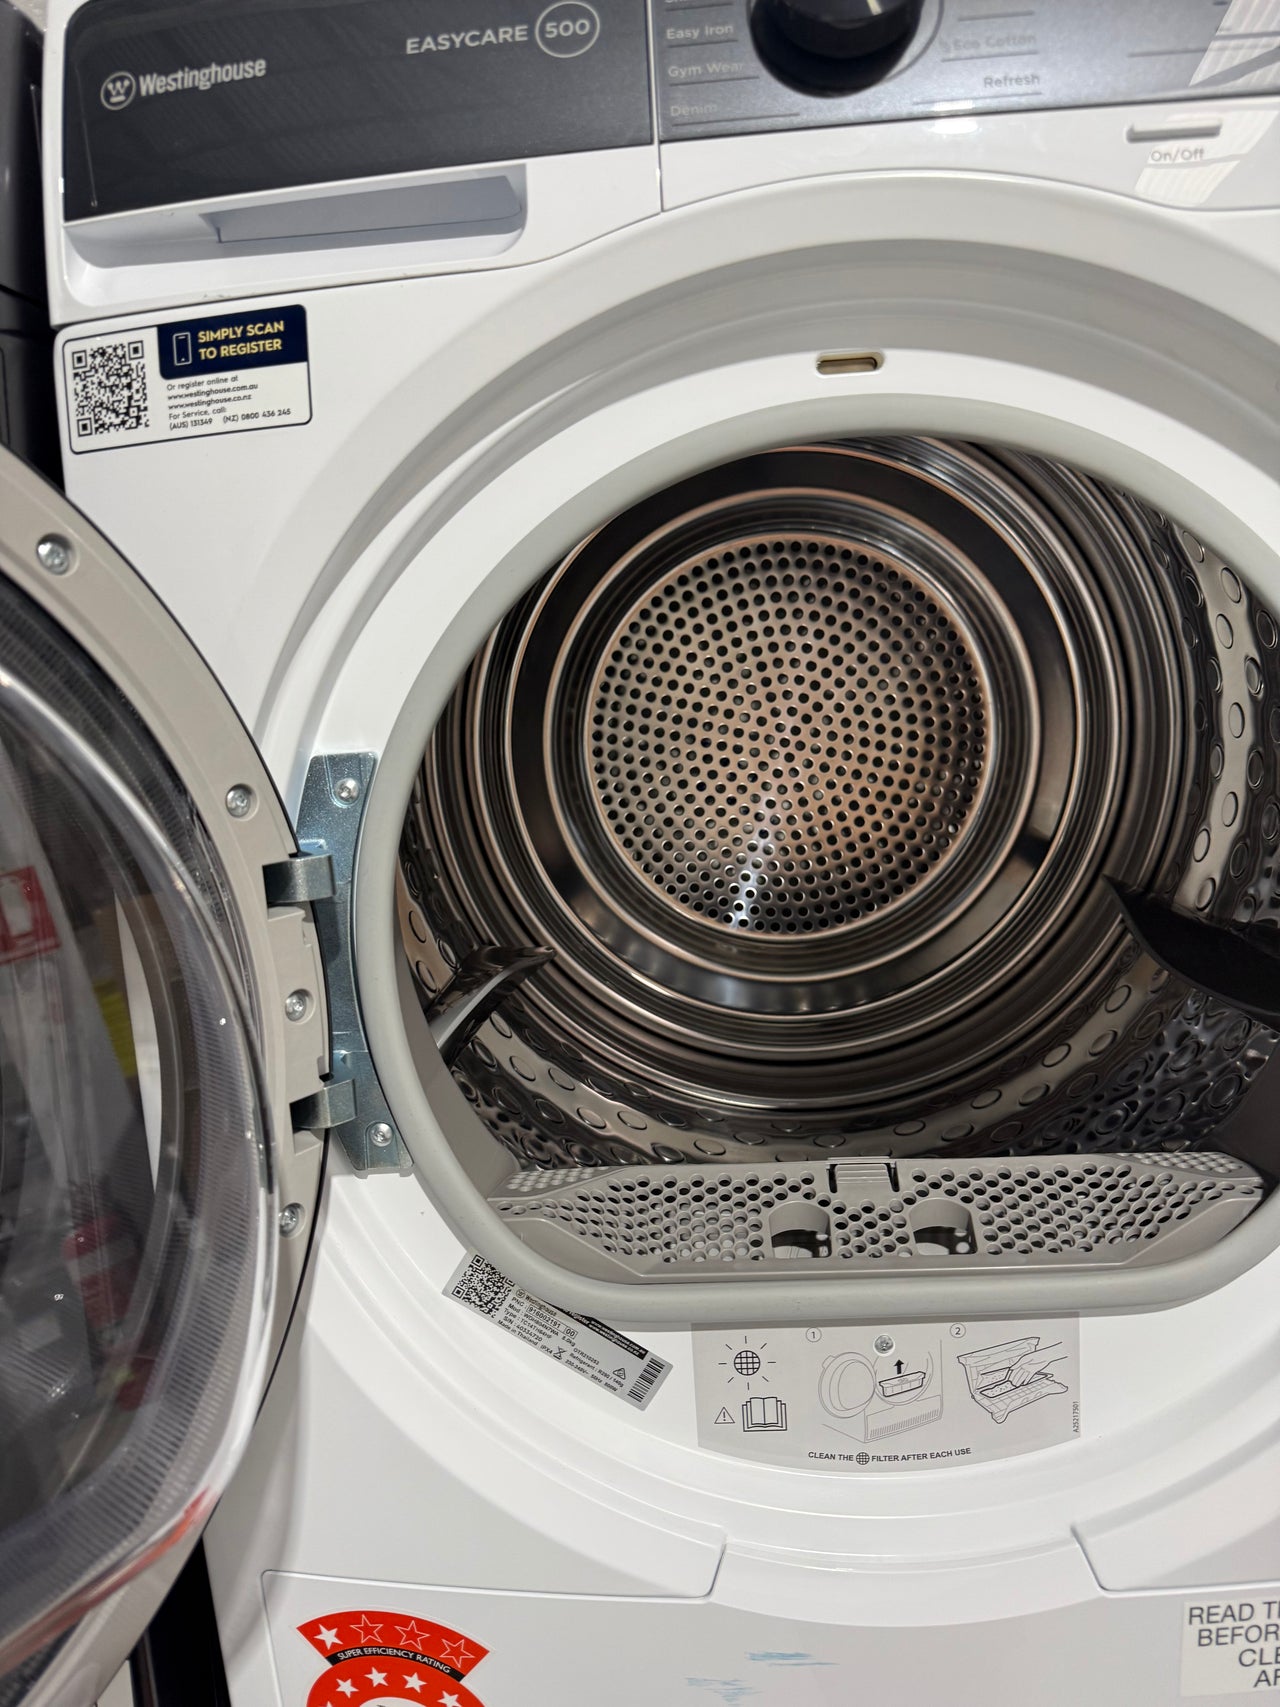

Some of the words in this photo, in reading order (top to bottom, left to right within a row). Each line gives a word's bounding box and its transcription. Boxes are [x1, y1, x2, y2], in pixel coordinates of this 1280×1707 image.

[406, 25, 528, 53] EASYCARE
[545, 18, 591, 38] 500
[666, 27, 699, 39] Easy
[705, 24, 733, 35] Iron
[139, 58, 267, 97] Westinghouse
[668, 65, 701, 78] Gym
[707, 62, 743, 73] Wear
[983, 74, 1040, 88] Refresh
[670, 103, 718, 116] Denim
[1151, 149, 1204, 162] On/Off
[198, 324, 244, 343] SIMPLY
[246, 320, 285, 338] SCAN
[198, 346, 217, 360] TO
[220, 339, 282, 358] REGISTER
[167, 384, 258, 400] www.westinghouse.com.au
[177, 380, 204, 391] register
[207, 377, 228, 386] online
[168, 394, 252, 410] www.westinghouse.co.nz
[169, 412, 180, 420] For
[182, 409, 210, 419] Service,
[169, 420, 189, 431] (AUS)
[223, 414, 239, 424] (NZ)
[241, 412, 260, 420] 0800
[262, 410, 276, 418] 436
[527, 1306, 561, 1328] 916002191
[516, 1331, 538, 1345] Thailand
[808, 1451, 836, 1460] CLEAN
[901, 1453, 928, 1461] AFTER
[930, 1451, 953, 1459] EACH
[954, 1448, 971, 1456] USE
[1189, 1603, 1255, 1625] READ
[337, 1648, 363, 1660] SUPER
[363, 1647, 414, 1659] EFFICIENCY
[416, 1654, 451, 1674] RATING
